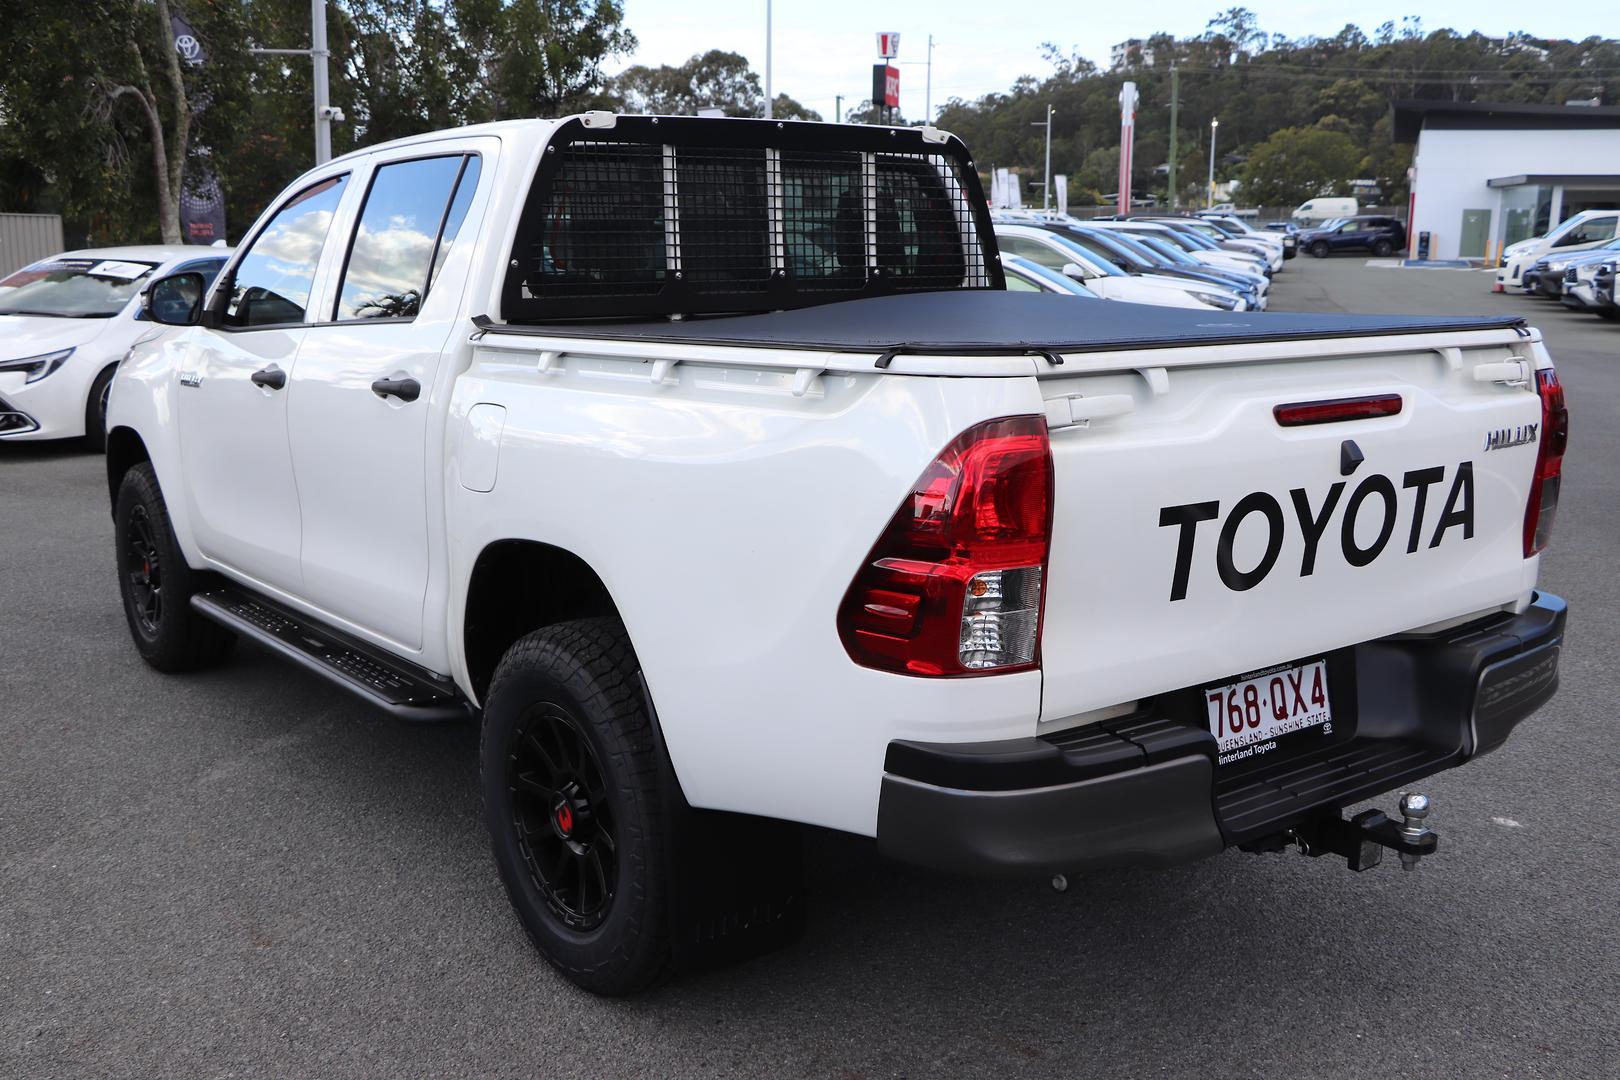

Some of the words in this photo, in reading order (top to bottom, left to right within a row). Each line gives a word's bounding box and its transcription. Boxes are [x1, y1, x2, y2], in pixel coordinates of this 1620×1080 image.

[1158, 460, 1475, 602] TOYOTA
[1269, 718, 1304, 737] SUNSHINE
[1253, 740, 1278, 755] Toyota
